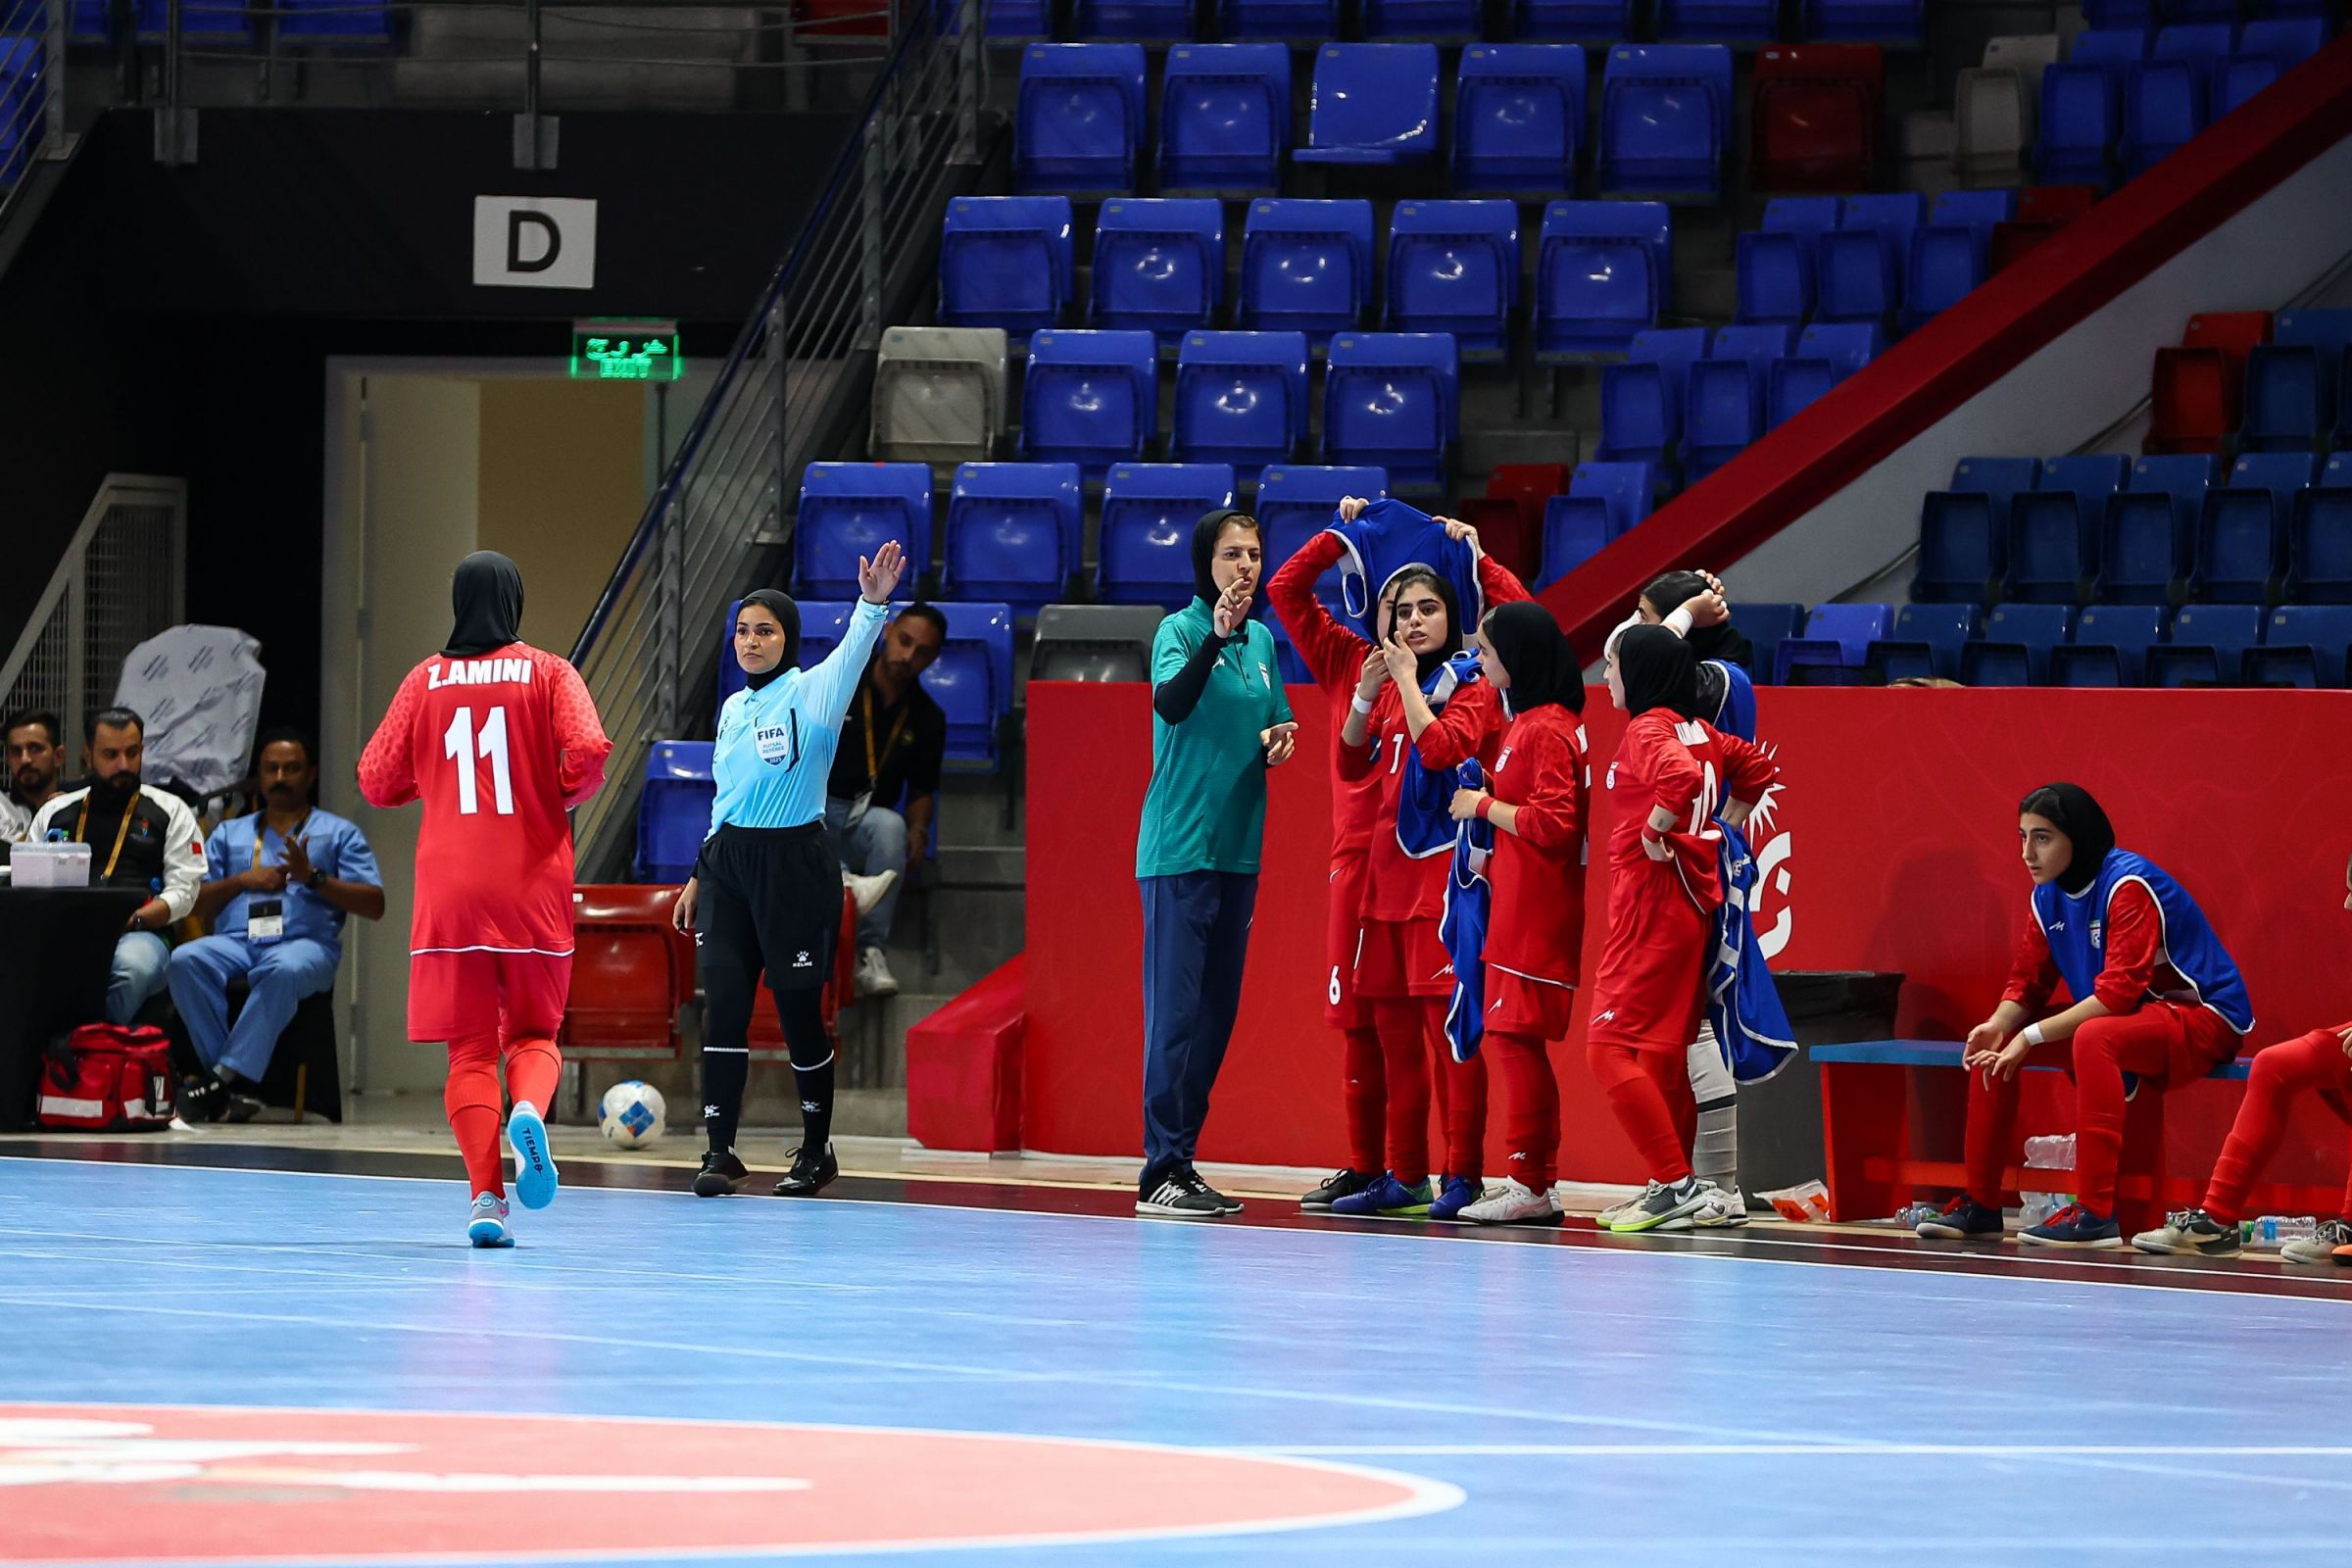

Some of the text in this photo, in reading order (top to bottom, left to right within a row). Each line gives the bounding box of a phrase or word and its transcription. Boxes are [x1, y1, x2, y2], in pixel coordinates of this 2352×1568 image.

[507, 210, 562, 272] D
[600, 358, 652, 378] EXIT
[427, 658, 533, 691] Z.AMINI
[758, 727, 784, 741] FIFA
[444, 706, 514, 814] 11
[1328, 964, 1342, 1005] 6
[522, 1128, 543, 1174] TIEMPO
